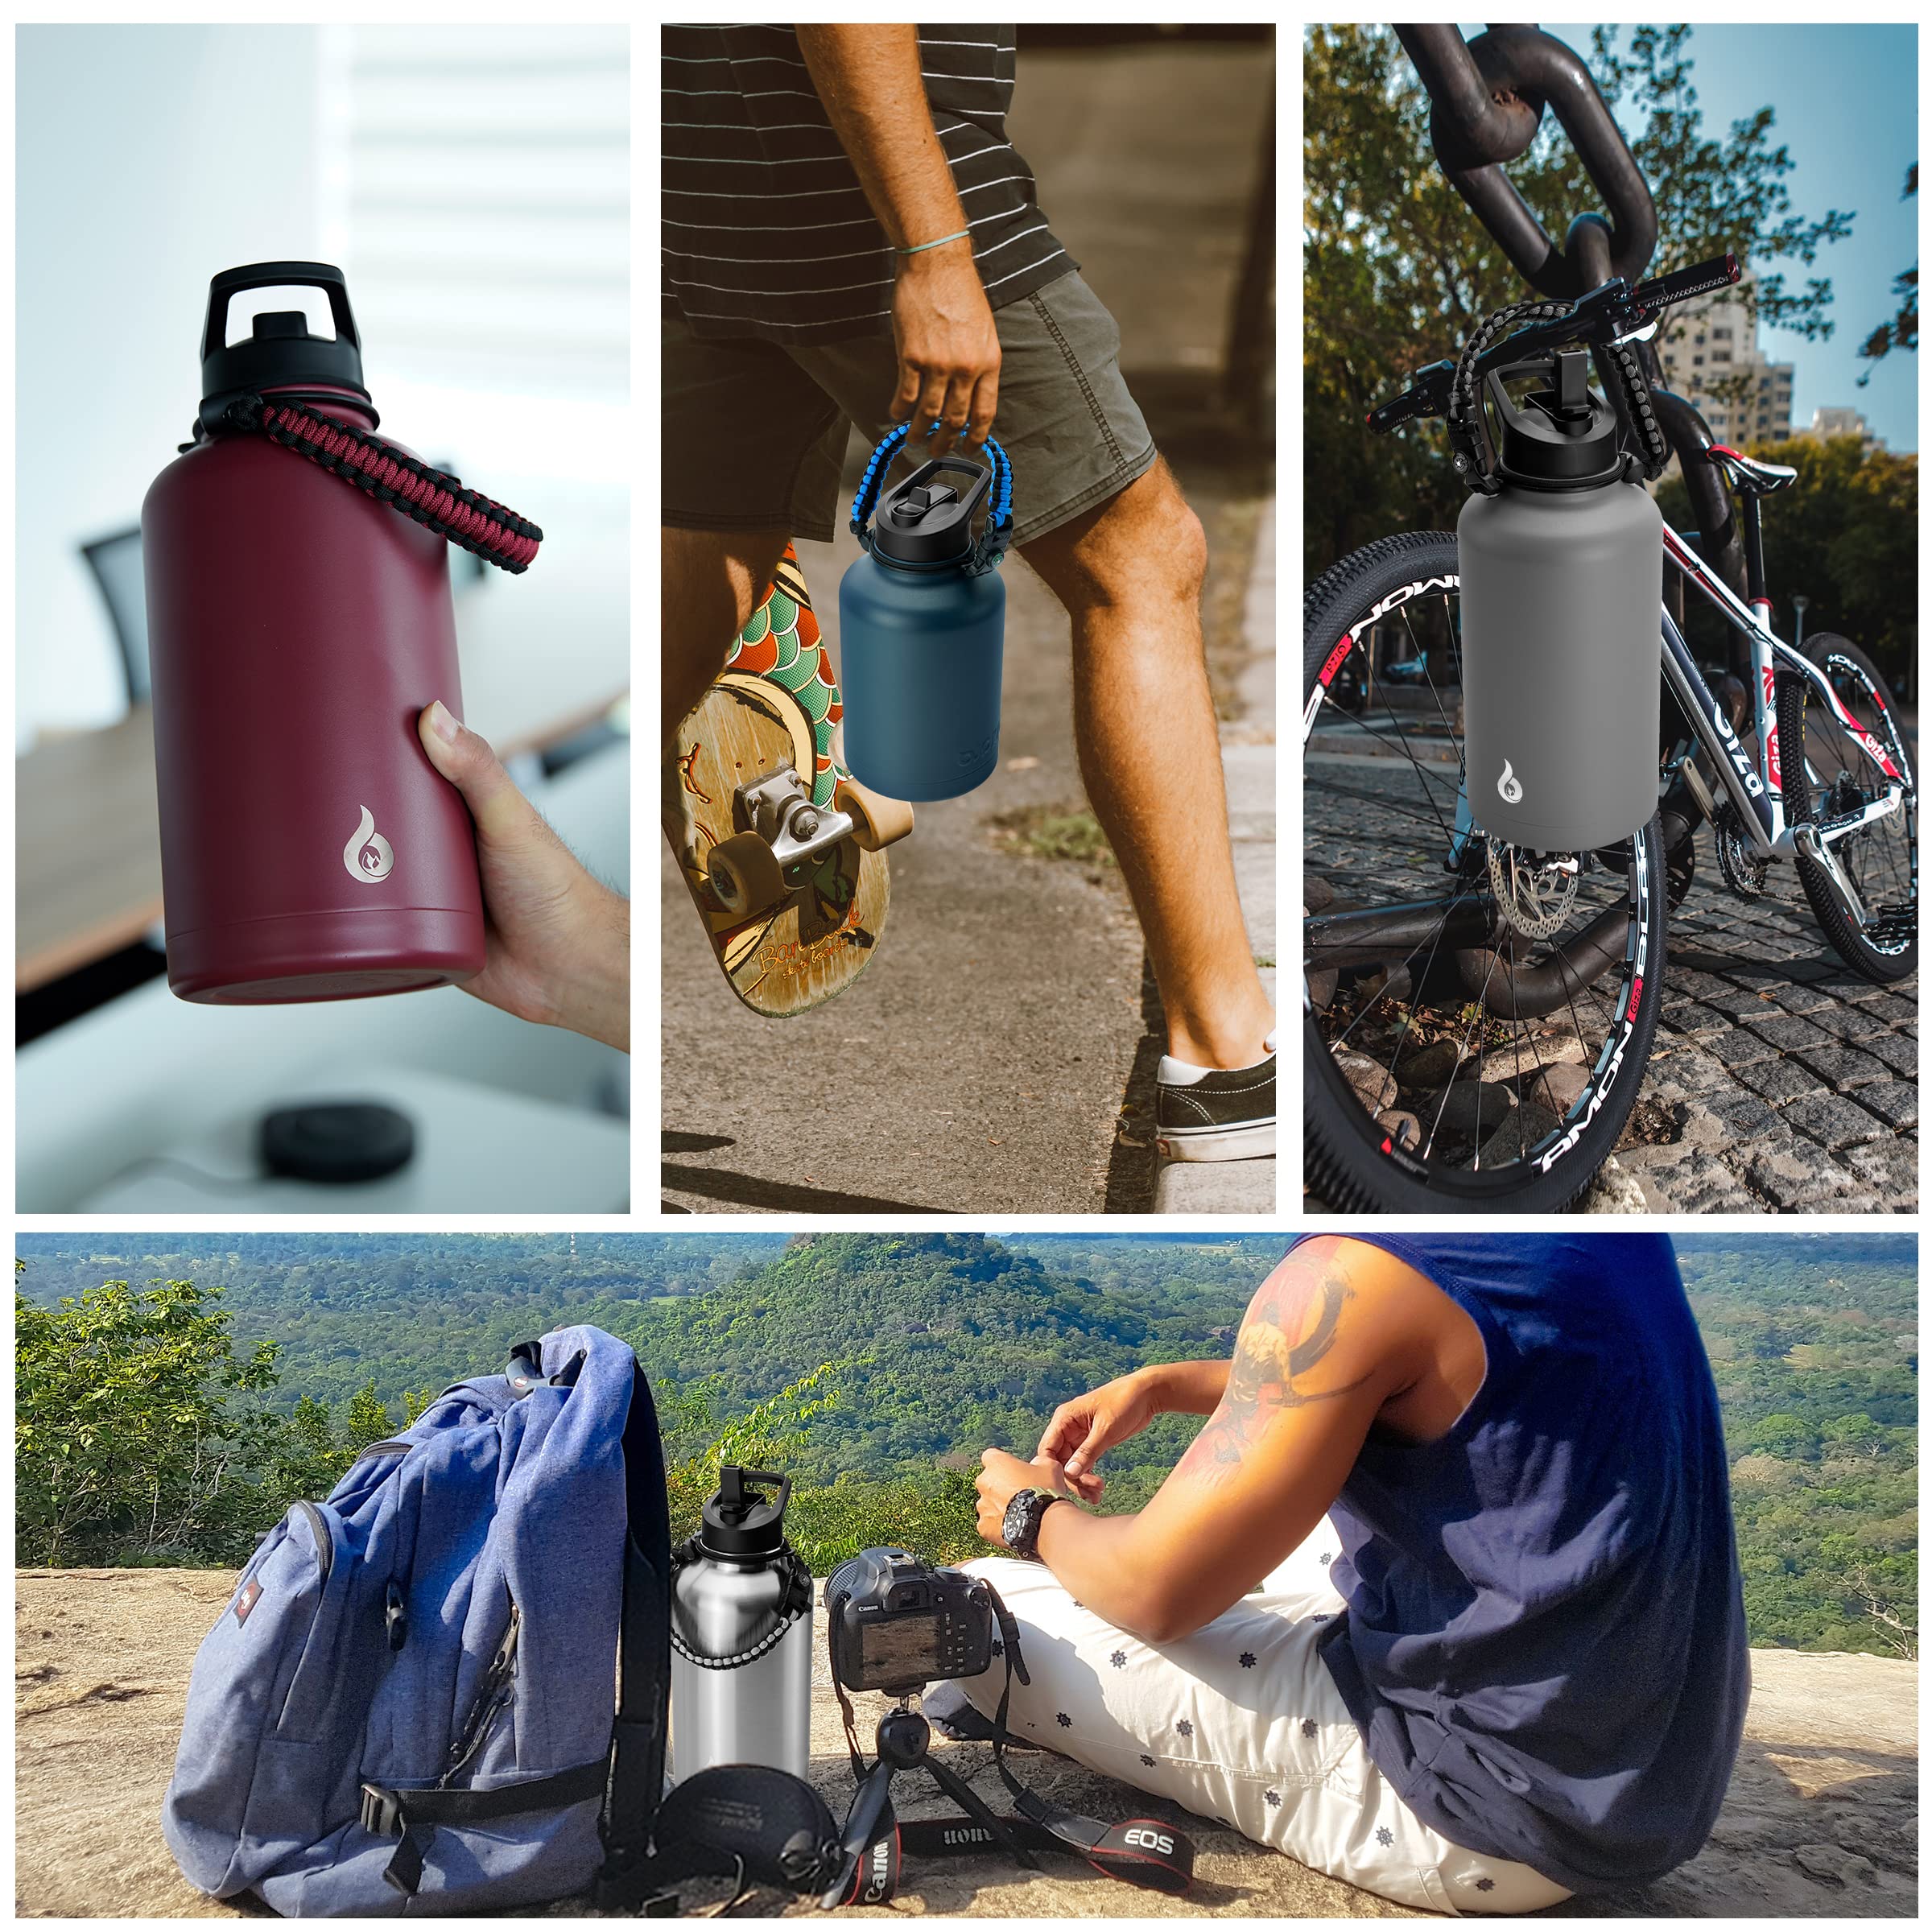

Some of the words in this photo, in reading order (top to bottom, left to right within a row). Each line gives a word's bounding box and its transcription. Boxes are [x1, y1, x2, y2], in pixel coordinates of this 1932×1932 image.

[1865, 733, 1887, 763] Giza
[811, 938, 848, 964] boards
[1630, 988, 1641, 1014] Giza
[1125, 1828, 1174, 1855] EOS
[864, 1841, 889, 1903] Canon
